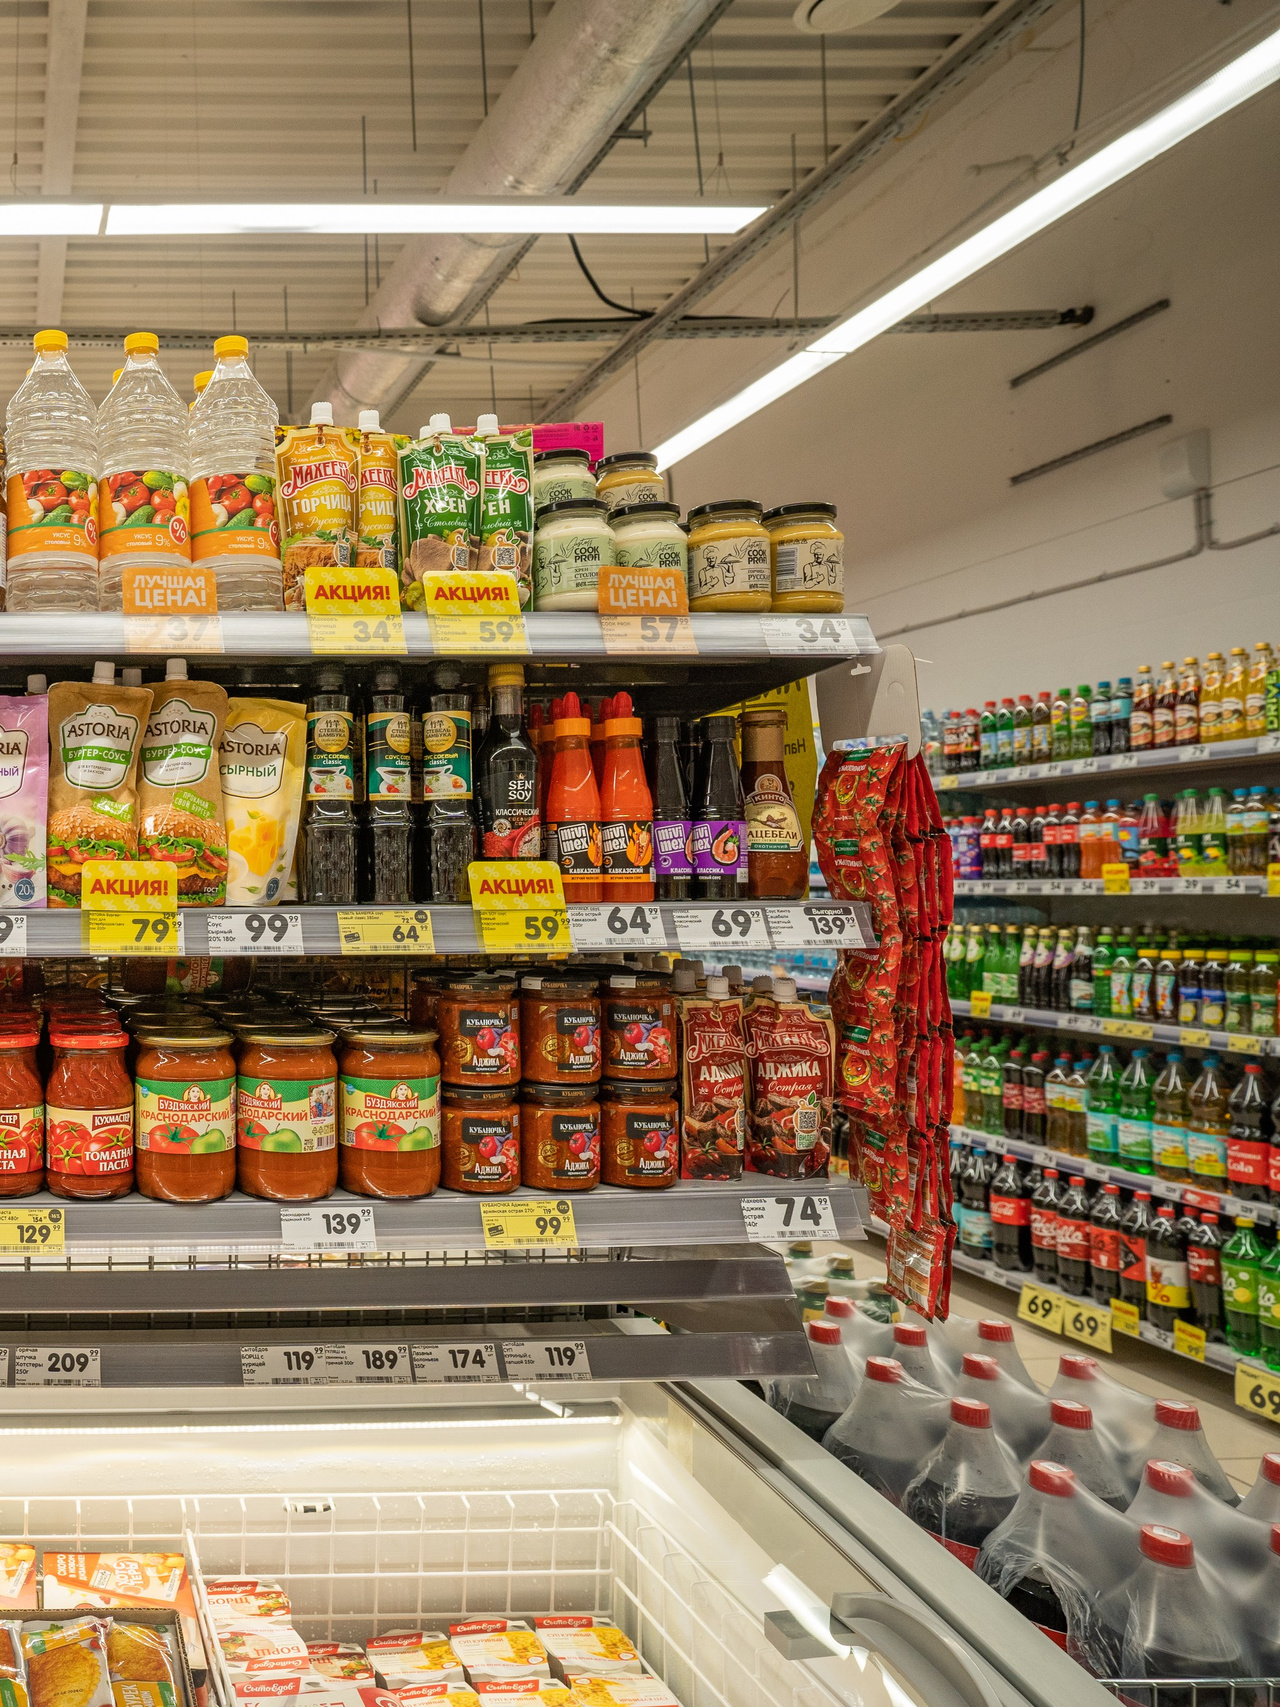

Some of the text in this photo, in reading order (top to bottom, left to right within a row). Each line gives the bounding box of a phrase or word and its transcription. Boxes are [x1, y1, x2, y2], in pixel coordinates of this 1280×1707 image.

[292, 494, 351, 516] ГОРЧИЦА
[574, 546, 599, 555] COOK
[574, 554, 601, 562] PROFI
[747, 548, 767, 557] COOK
[133, 575, 205, 588] ЛУЧШАЯ
[608, 575, 675, 590] ЛУЧШАЯ
[135, 590, 206, 607] ЦЕНА!
[314, 585, 391, 600] АКЦИЯ!
[434, 587, 510, 601] АКЦИЯ!
[609, 589, 677, 607] ЦЕНА!
[167, 617, 211, 641] 37
[353, 621, 391, 642] 34
[479, 621, 514, 642] 59
[640, 618, 678, 643] 57
[796, 619, 841, 643] 34
[66, 720, 131, 740] ASTORIA
[144, 719, 208, 737] ASTORIA
[68, 748, 127, 762] БУРГЕР-СОУС
[145, 746, 206, 758] БУРГЕР-СОУС
[219, 741, 281, 756] ASTORIA
[220, 764, 277, 778] СЫРНЫЙ
[509, 780, 532, 790] SEN
[508, 790, 532, 802] SOY
[90, 879, 169, 897] АКЦИЯ!
[479, 878, 554, 895] АКЦИЯ!
[245, 915, 288, 942] 99
[524, 916, 559, 940] 59
[608, 906, 651, 934] 64
[712, 910, 752, 937] 69
[809, 916, 845, 935] 139
[131, 919, 170, 943] 79
[392, 924, 419, 942] 64
[466, 1018, 504, 1026] КУБАНОЧКА
[758, 1060, 821, 1079] АДЖИКА
[769, 1080, 813, 1093] Острая
[159, 1099, 211, 1111] БУЗДЯКСКИЙ
[366, 1097, 418, 1109] БУЗДЯКСКИЙ
[140, 1109, 231, 1123] КРАСНОДАРСКИЙ
[345, 1106, 437, 1121] КРАСНОДАРСКИЙ
[469, 1125, 506, 1134] КУБАНОЧКА
[775, 1197, 822, 1227] 74
[322, 1213, 361, 1235] 139
[535, 1217, 561, 1235] 99
[17, 1224, 51, 1243] 129
[1028, 1296, 1052, 1319] 69
[1072, 1312, 1099, 1337] 69
[48, 1352, 89, 1373] 209
[283, 1351, 315, 1371] 119
[362, 1350, 398, 1370] 189
[448, 1349, 486, 1368] 174
[545, 1347, 576, 1367] 119
[208, 1597, 250, 1605] БОРЩ
